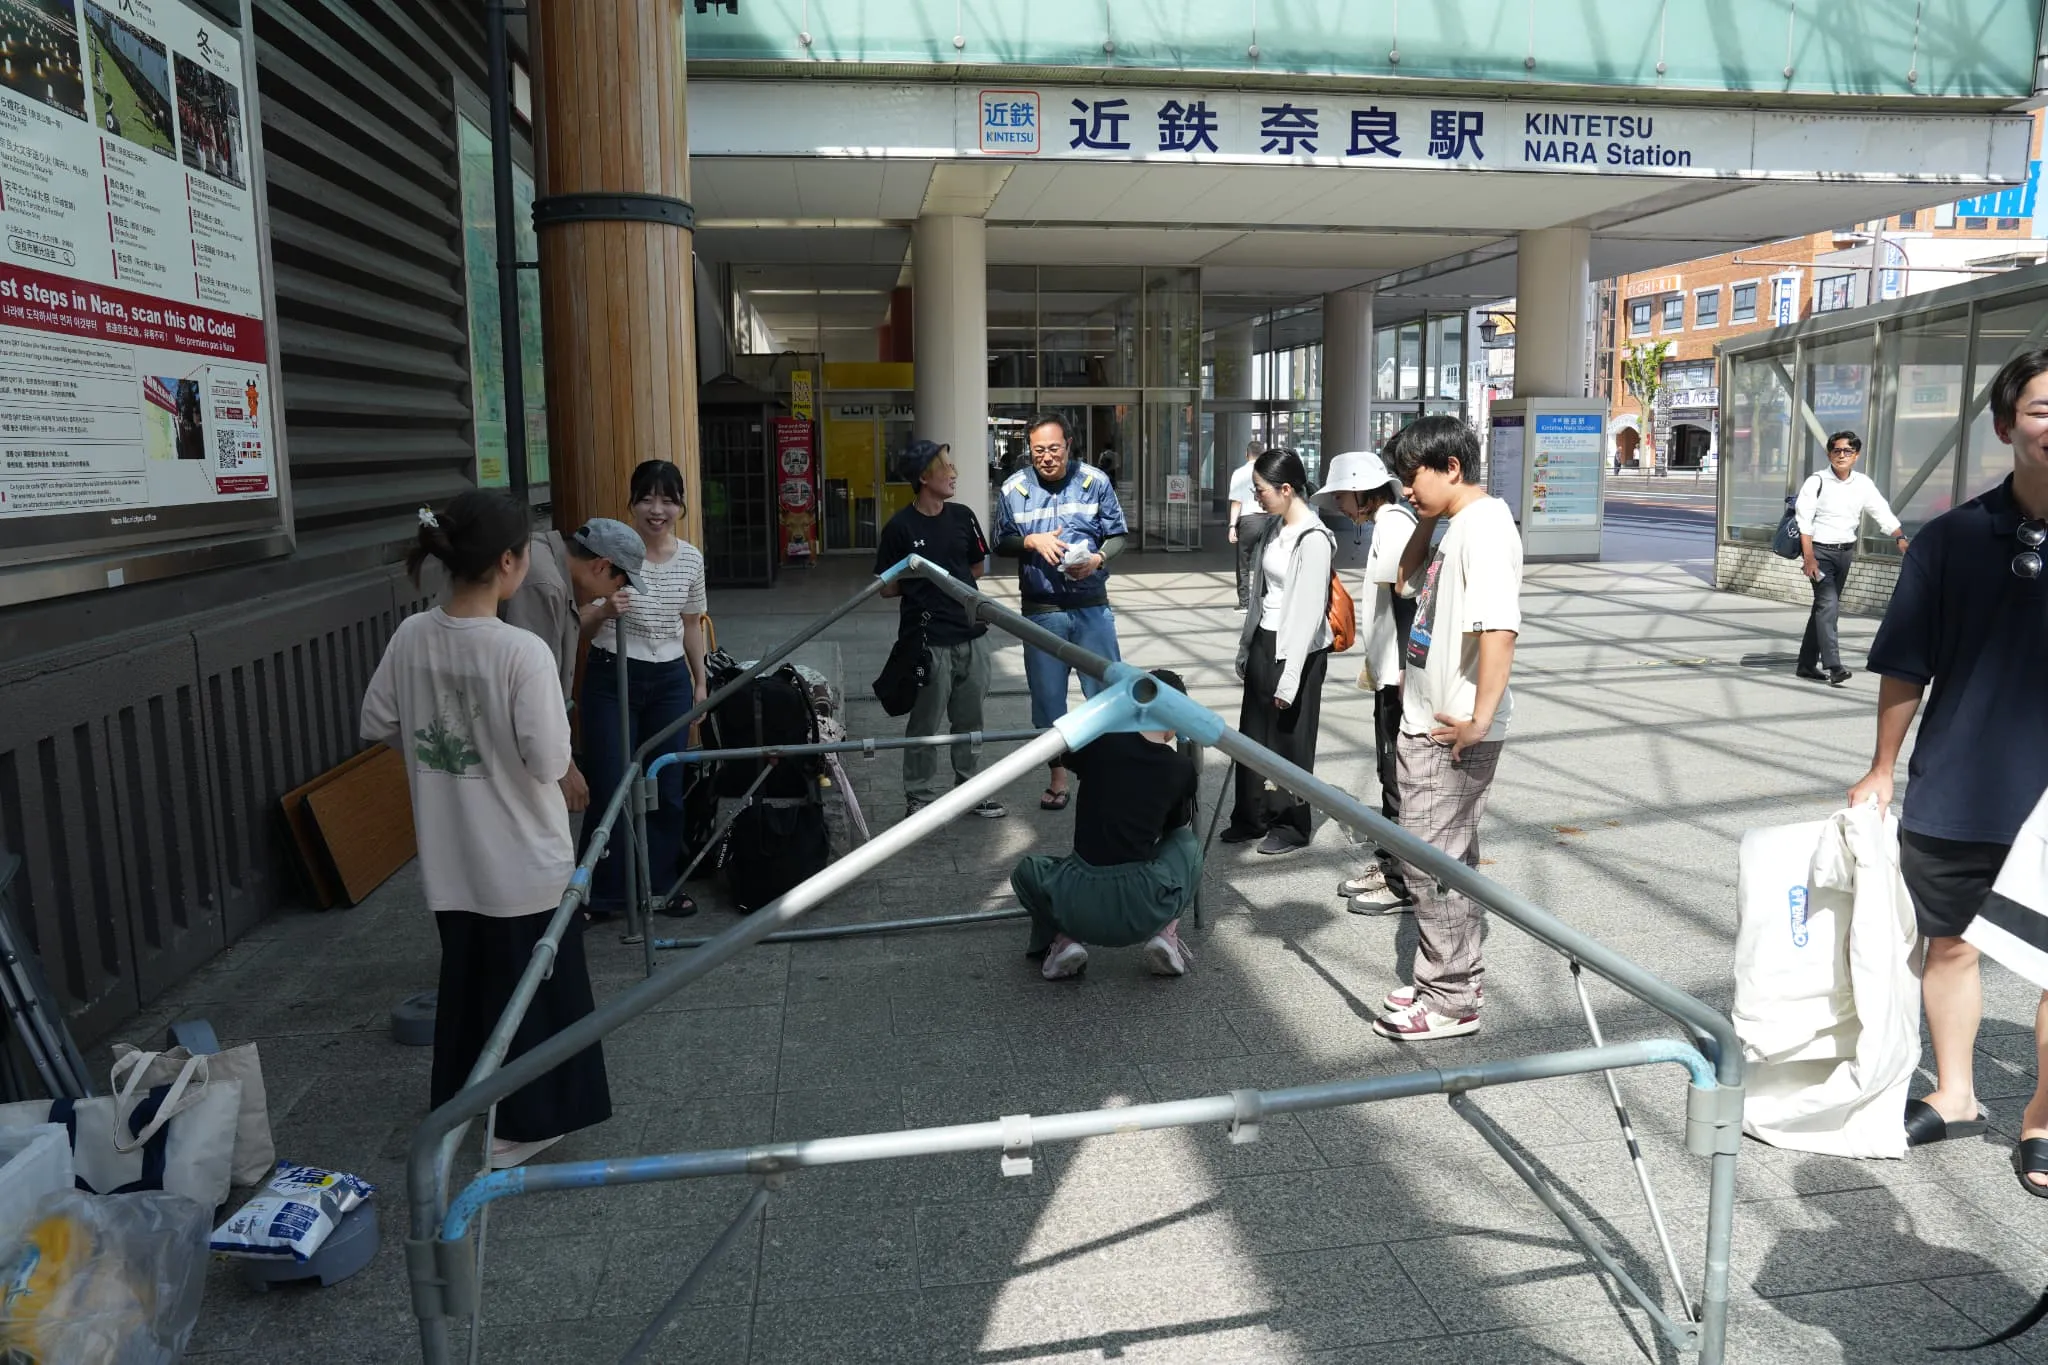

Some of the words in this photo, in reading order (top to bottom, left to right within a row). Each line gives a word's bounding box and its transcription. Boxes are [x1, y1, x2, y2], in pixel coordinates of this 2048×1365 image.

[197, 28, 212, 64] 冬
[985, 102, 1034, 128] 近鉄
[1525, 113, 1653, 139] KINTETSU
[985, 131, 1034, 145] KINTETSU
[1525, 140, 1597, 164] NARA
[1606, 142, 1691, 167] Station
[22, 282, 69, 311] steps
[71, 289, 87, 311] in
[90, 294, 128, 322] Nara,
[131, 306, 162, 325] scan
[164, 309, 186, 330] this
[188, 314, 206, 334] QR
[207, 318, 237, 339] Code!
